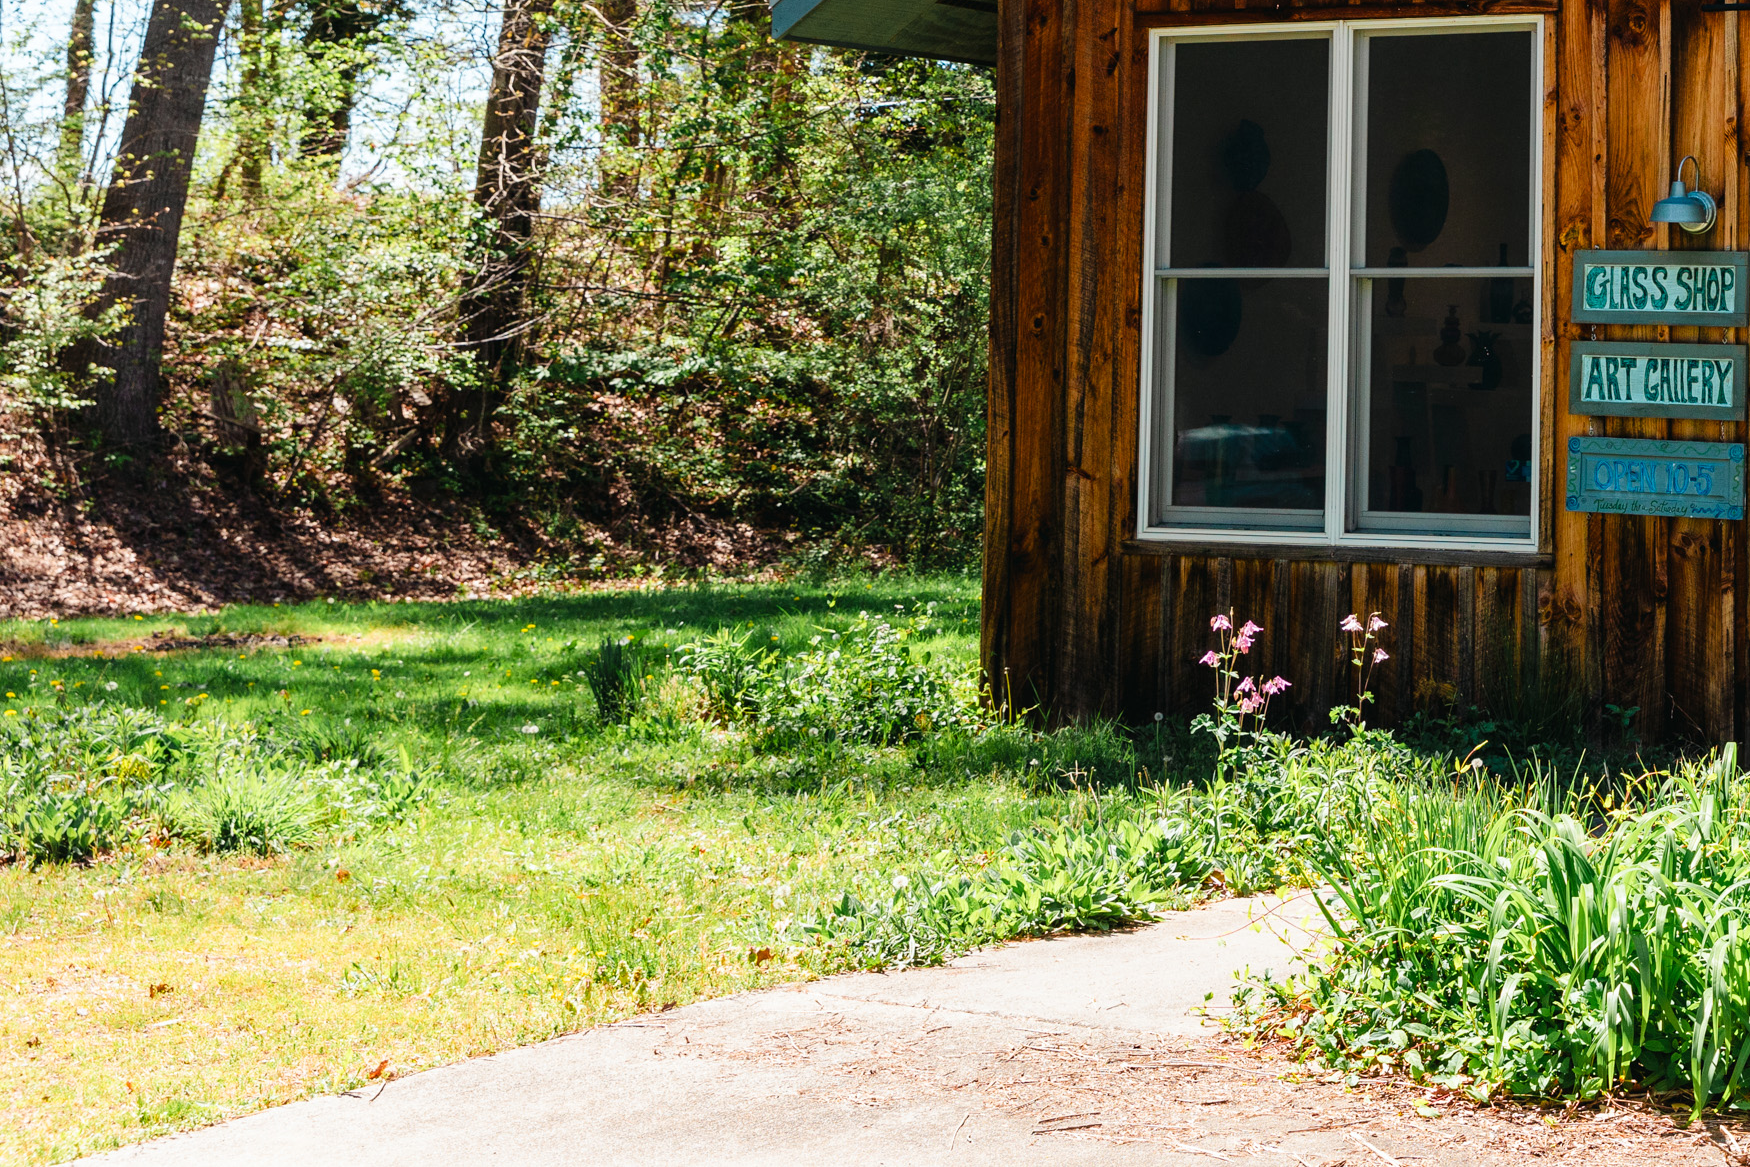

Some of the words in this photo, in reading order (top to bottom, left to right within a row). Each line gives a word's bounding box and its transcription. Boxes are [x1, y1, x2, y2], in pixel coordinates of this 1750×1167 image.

[1586, 266, 1669, 310] GLASS
[1673, 267, 1735, 311] SHOP
[1584, 357, 1637, 401] ART
[1643, 358, 1733, 404] GALLERY
[1594, 460, 1657, 493] OPEN
[1665, 462, 1715, 496] 10-5
[1594, 498, 1628, 514] Tuesday
[1648, 499, 1689, 516] Saturday
